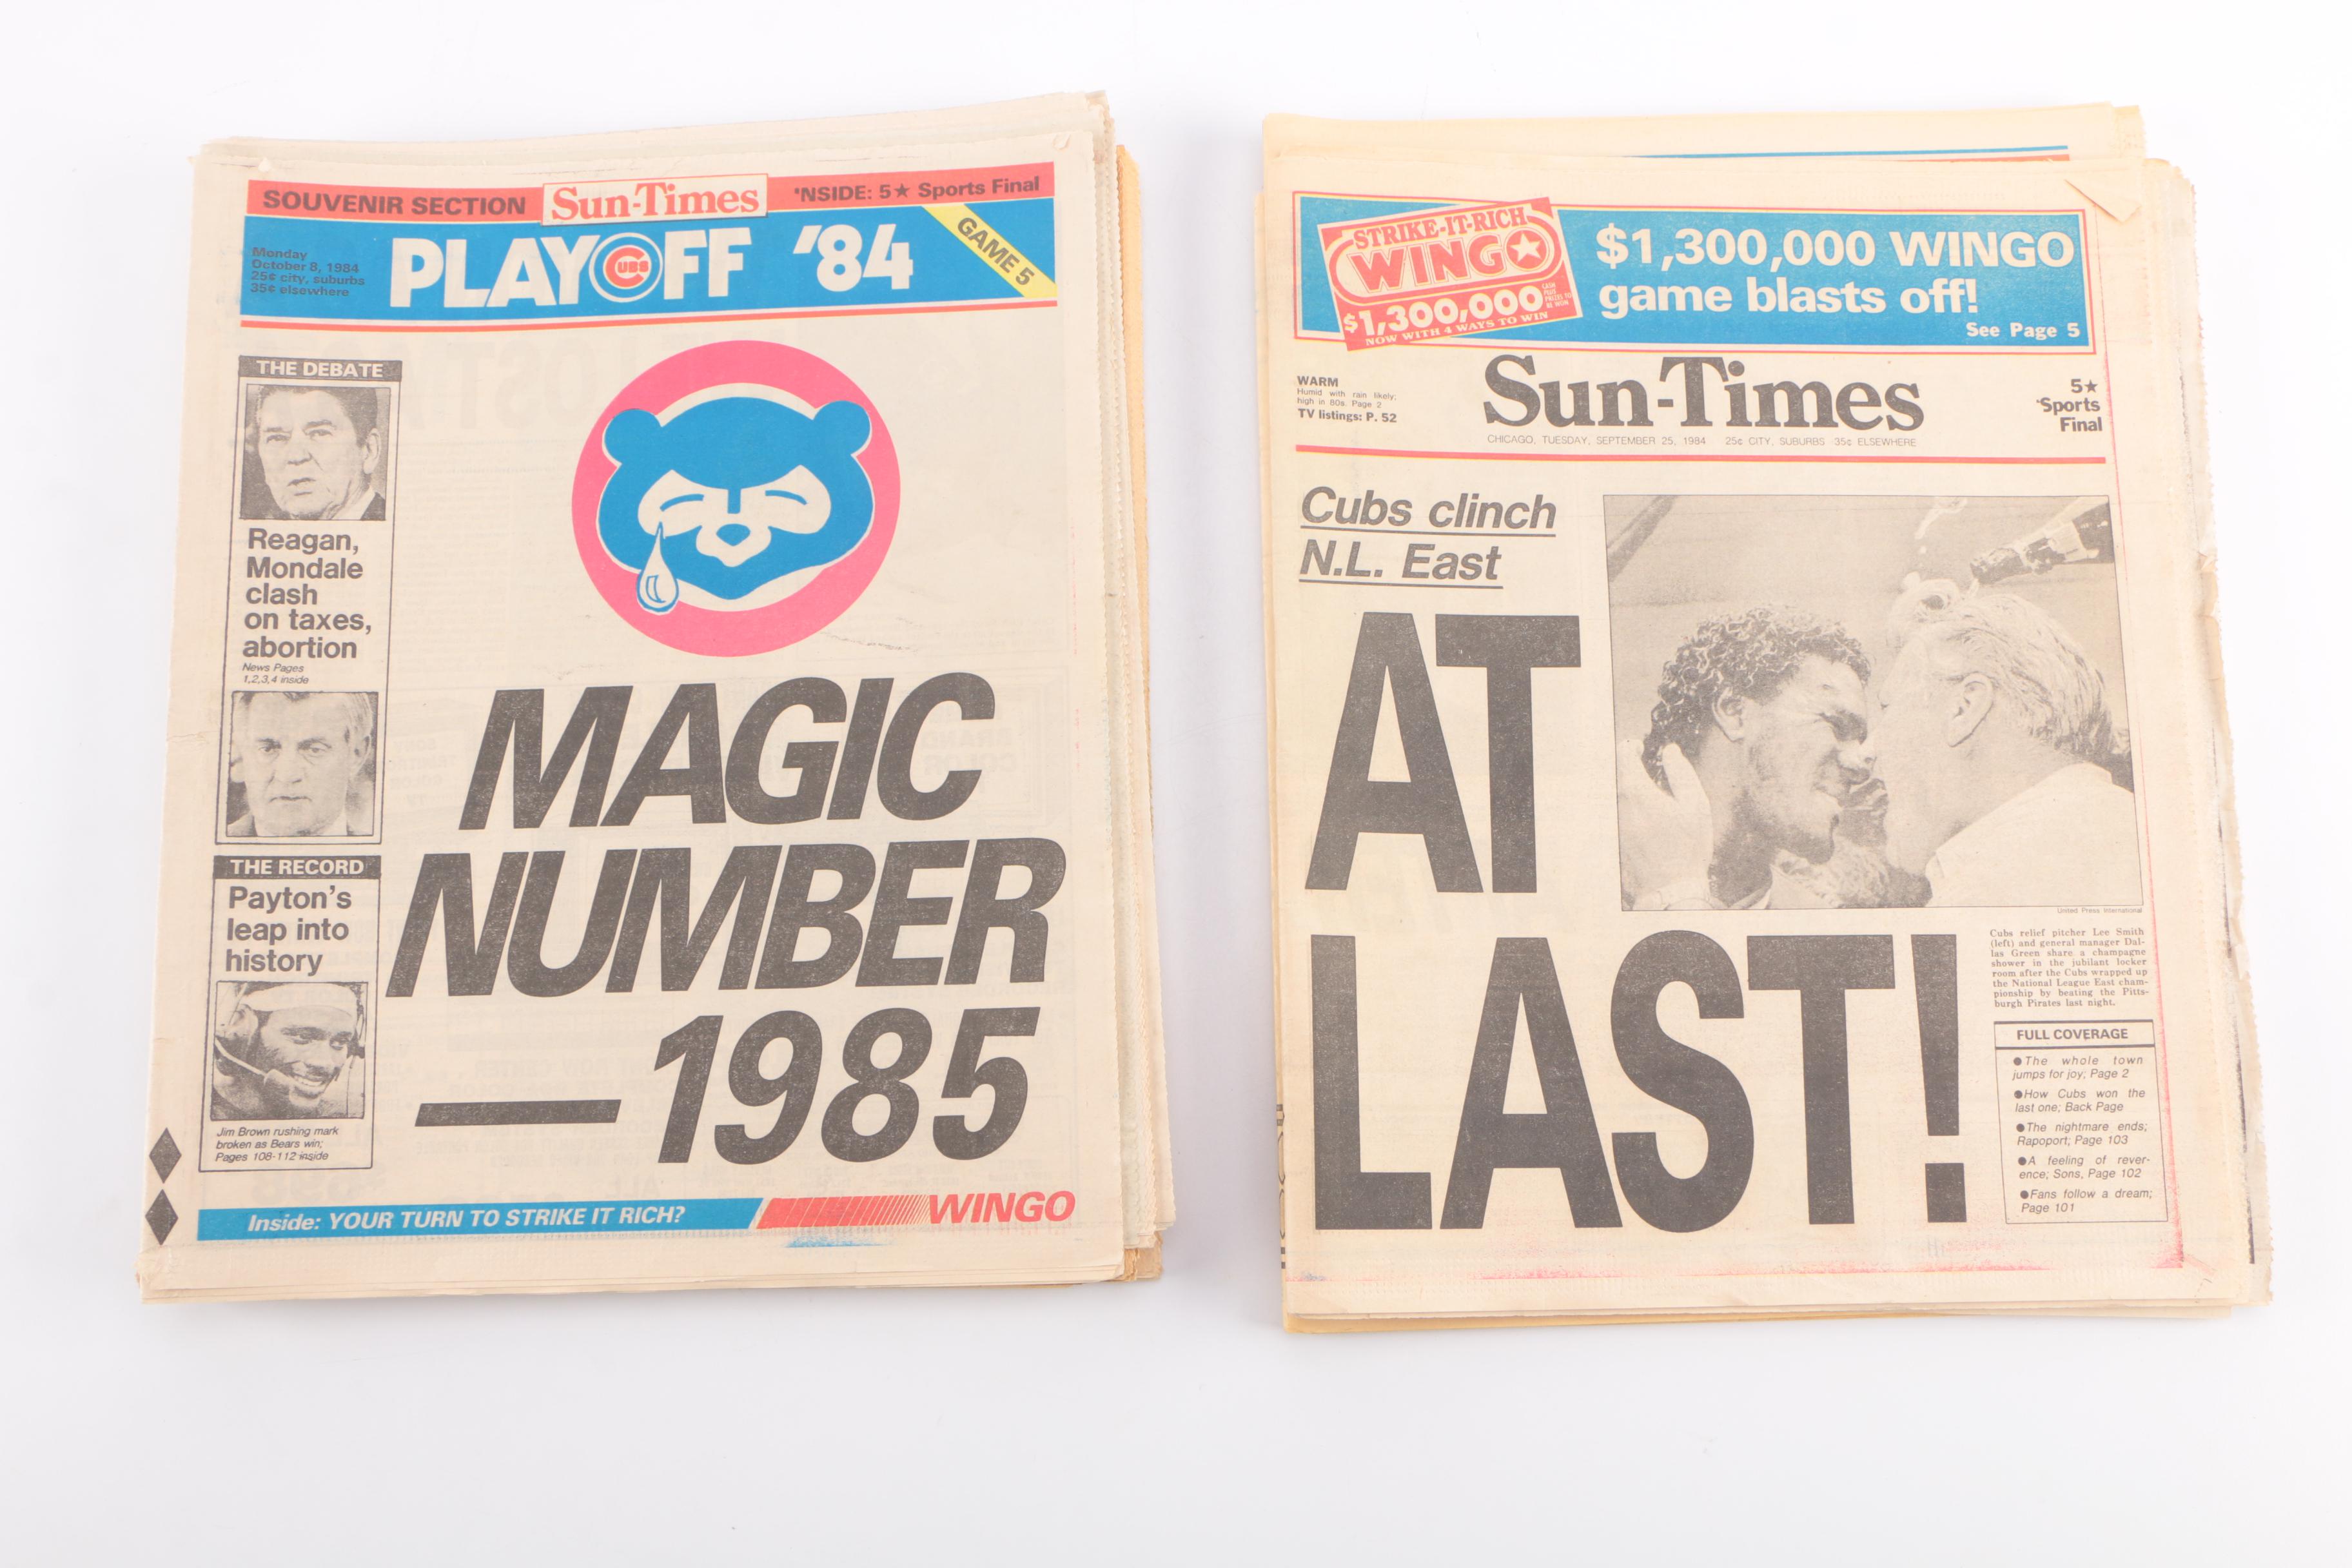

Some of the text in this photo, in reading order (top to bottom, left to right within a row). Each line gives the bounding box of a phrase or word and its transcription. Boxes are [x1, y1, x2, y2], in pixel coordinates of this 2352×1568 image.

[918, 181, 985, 200] Sports
[992, 176, 1040, 194] Final
[263, 190, 525, 215] SOUVENIR SECTION
[551, 182, 760, 220] Sun-Times
[1352, 207, 1529, 250] STRIKE-IT-RICH
[252, 247, 308, 261] Monday
[957, 217, 1035, 286] GAME 5
[1596, 222, 2074, 273] $1,300,000 WINGO
[251, 259, 359, 273] October 8, 1984
[389, 227, 752, 308] PLAYOFF
[251, 271, 365, 285] 25¢ city, suburbs
[250, 283, 349, 297] 35¢ elsewhere
[1599, 277, 1979, 319] game blasts off!
[1344, 285, 1544, 337] $1,300,000
[1366, 335, 1398, 346] NOW
[1403, 328, 1440, 340] WITH
[1456, 320, 1494, 332] WAYS
[1498, 317, 1517, 326] TO
[1521, 311, 1548, 322] WIN
[1966, 322, 2080, 341] See Page 5
[256, 360, 384, 378] THE DEBATE
[1297, 376, 1339, 387] WARM
[1482, 354, 1925, 431] Sun-Times
[1298, 408, 1397, 423] TV listings: P. 52
[2060, 416, 2103, 432] Final
[1487, 435, 1705, 446] CHICAGO, TUESDAY, SEPTEMBER 25, 1984
[1725, 436, 1743, 446] 25¢
[1749, 437, 1774, 446] CITY,
[1779, 437, 1825, 446] SUBURBS
[1858, 438, 1917, 447] ELSEWHERE
[1302, 486, 1557, 529] Cubs clinch
[248, 527, 358, 555] Reagan,
[246, 556, 364, 579] Mondale
[1300, 538, 1502, 580] N.L. East
[246, 582, 318, 605] clash
[244, 609, 371, 635] on taxes,
[242, 636, 357, 658] abortion
[242, 662, 304, 674] News Pages
[243, 674, 309, 684] 1,2,3,4 inside
[458, 672, 995, 830] MAGIC
[1305, 611, 1582, 893] AT
[230, 859, 364, 875] THE RECORD
[229, 885, 351, 914] Payton's
[385, 838, 1067, 997] NUMBER
[227, 917, 349, 946] leap into
[1990, 928, 2144, 937] Cubs relief pitcher Lee Smith
[2040, 939, 2075, 948] general
[2080, 939, 2120, 947] manager
[226, 948, 323, 977] history
[2017, 1029, 2128, 1040] FULL COVERAGE
[2025, 1055, 2143, 1065] The whole town
[1311, 929, 1967, 1233] LAST!
[2012, 1069, 2129, 1081] jumps for joy; Page 2
[2024, 1090, 2049, 1099] How
[2058, 1089, 2086, 1099] Cubs
[2128, 1088, 2146, 1097] the
[2015, 1102, 2124, 1113] last one; Back Page
[217, 1126, 339, 1137] Jim Brown rushing mark
[2027, 1122, 2148, 1132] The nightmare ends;
[215, 1140, 251, 1149] broken
[271, 1139, 300, 1148] Bears
[304, 1139, 323, 1149] win;
[2017, 1135, 2128, 1147] Rapoport; Page 103
[215, 1152, 329, 1163] Pages 108-112 inside
[2028, 1155, 2150, 1166] A feeling of rever-
[2019, 1168, 2141, 1180] ence; Sons, Page 102
[2030, 1190, 2057, 1199] Fans
[2063, 1189, 2095, 1199] follow
[2115, 1189, 2152, 1199] dream;
[929, 1190, 1076, 1224] WINGO
[2022, 1203, 2075, 1213] Page 101
[248, 1206, 686, 1231] Inside: YOUR TURN TO STRIKE IT RICH?
